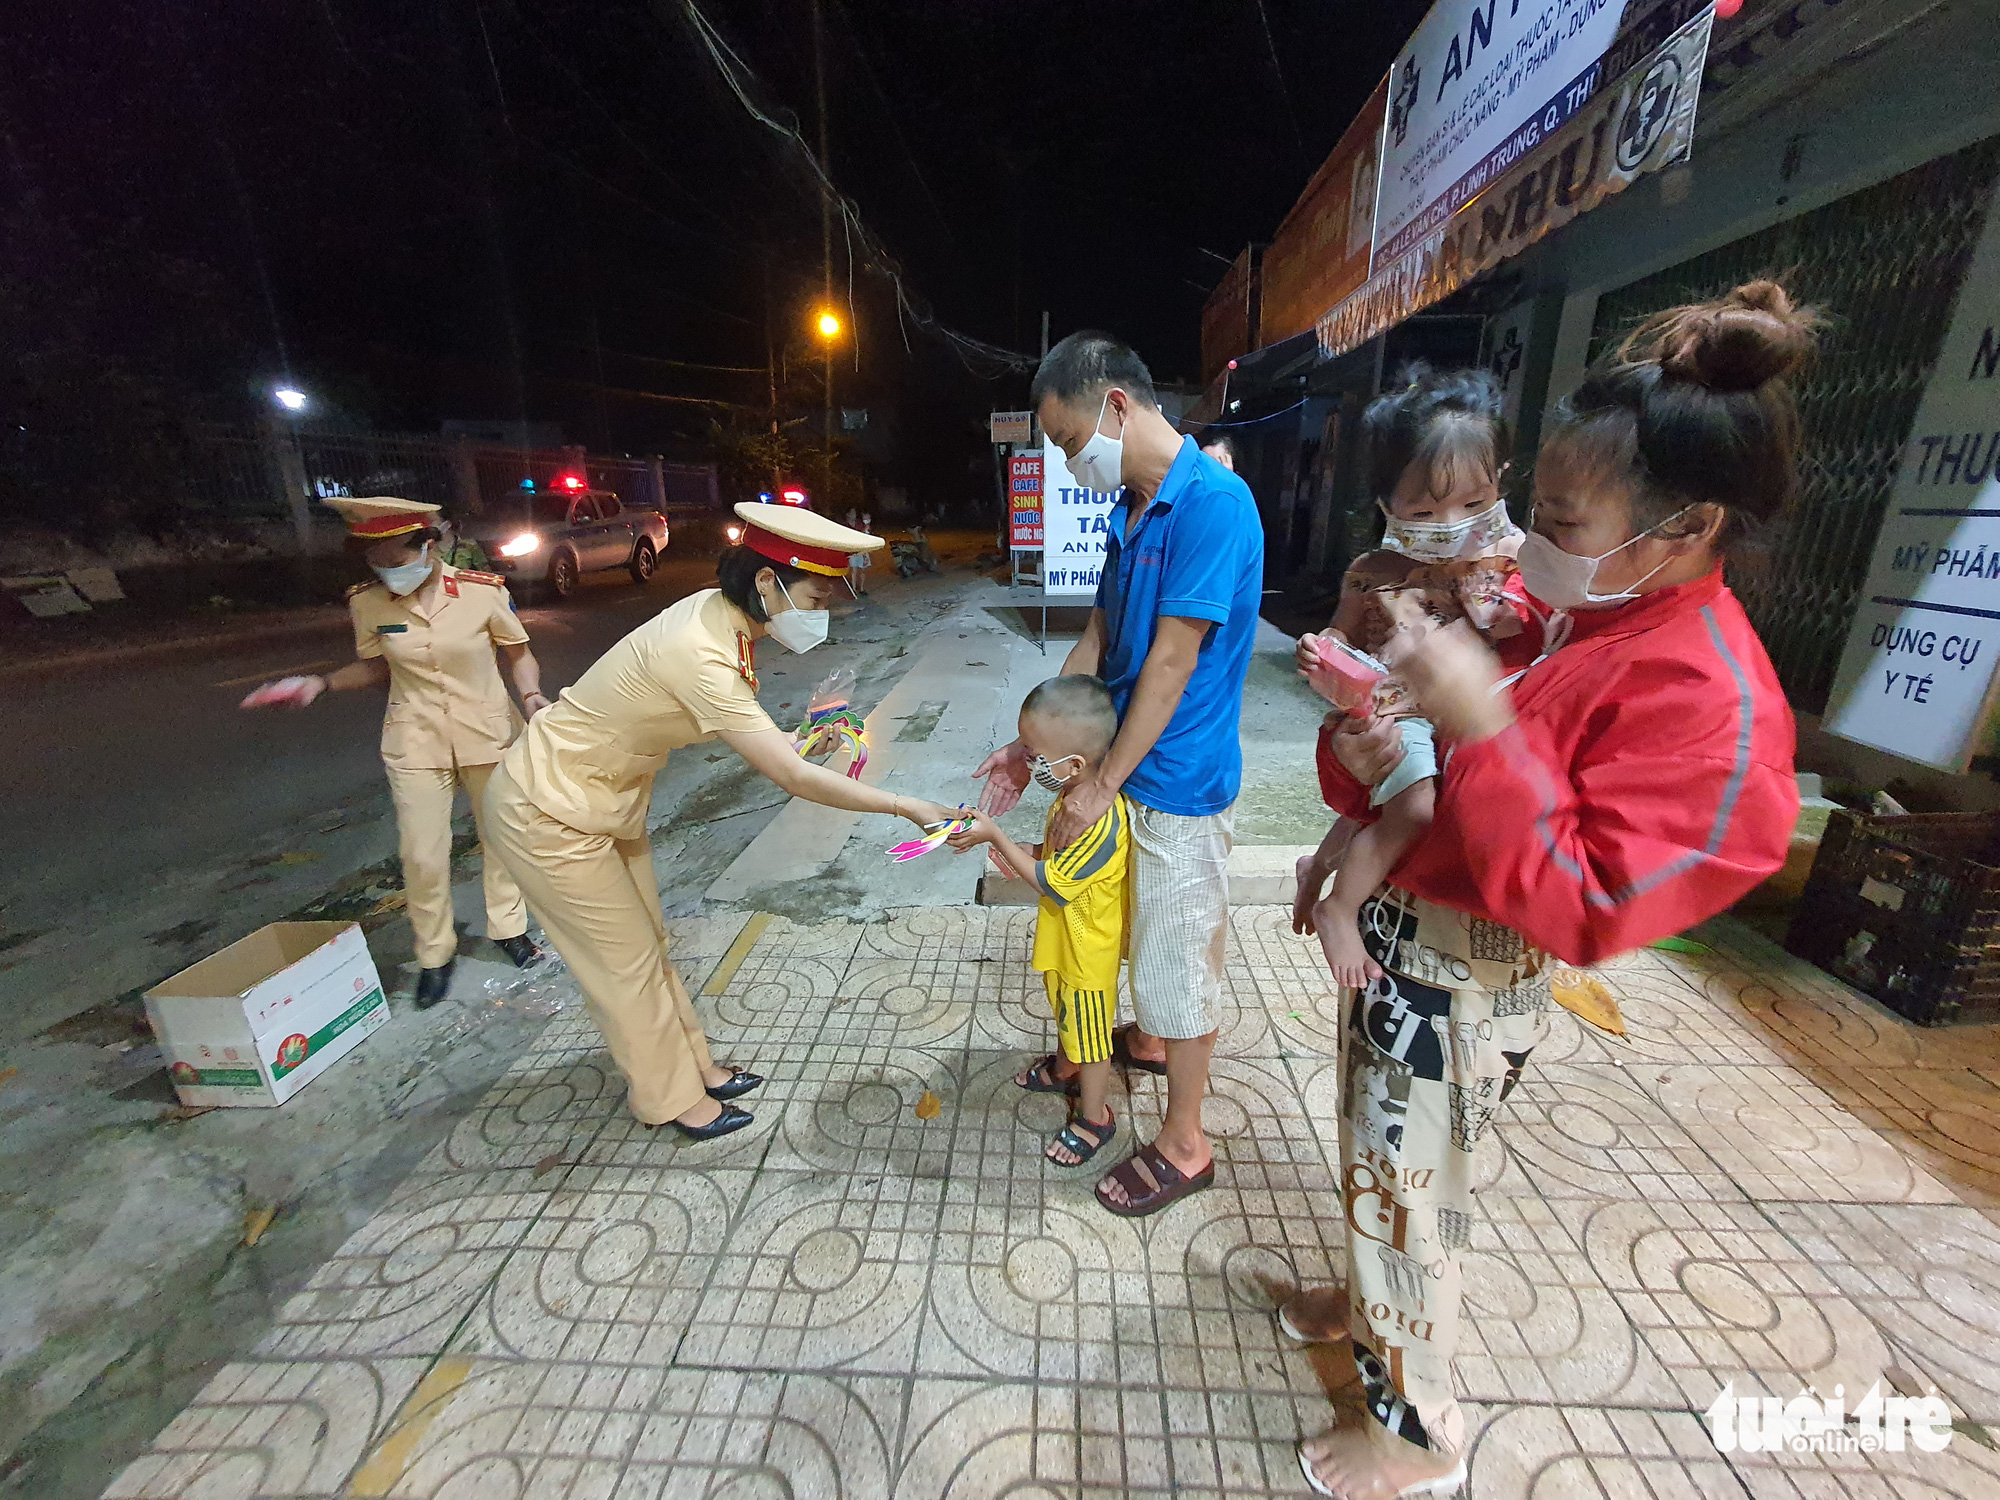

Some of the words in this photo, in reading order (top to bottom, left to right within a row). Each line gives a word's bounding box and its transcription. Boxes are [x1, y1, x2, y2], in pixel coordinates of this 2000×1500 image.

[1436, 0, 1495, 104] AN
[1461, 163, 1488, 200] LINH
[1490, 121, 1540, 177] TRUNG,
[1544, 104, 1560, 132] Q.
[1013, 462, 1040, 475] CAFE
[1917, 430, 2000, 486] THU
[1013, 478, 1039, 491] CAFE
[1013, 495, 1038, 508] SINH
[1062, 542, 1088, 553] AN
[1049, 567, 1067, 586] MỸ
[1871, 623, 1937, 657] DỤNG
[1942, 635, 1982, 671] CỤ
[1884, 669, 1901, 695] Y
[1903, 673, 1934, 704] TẾ
